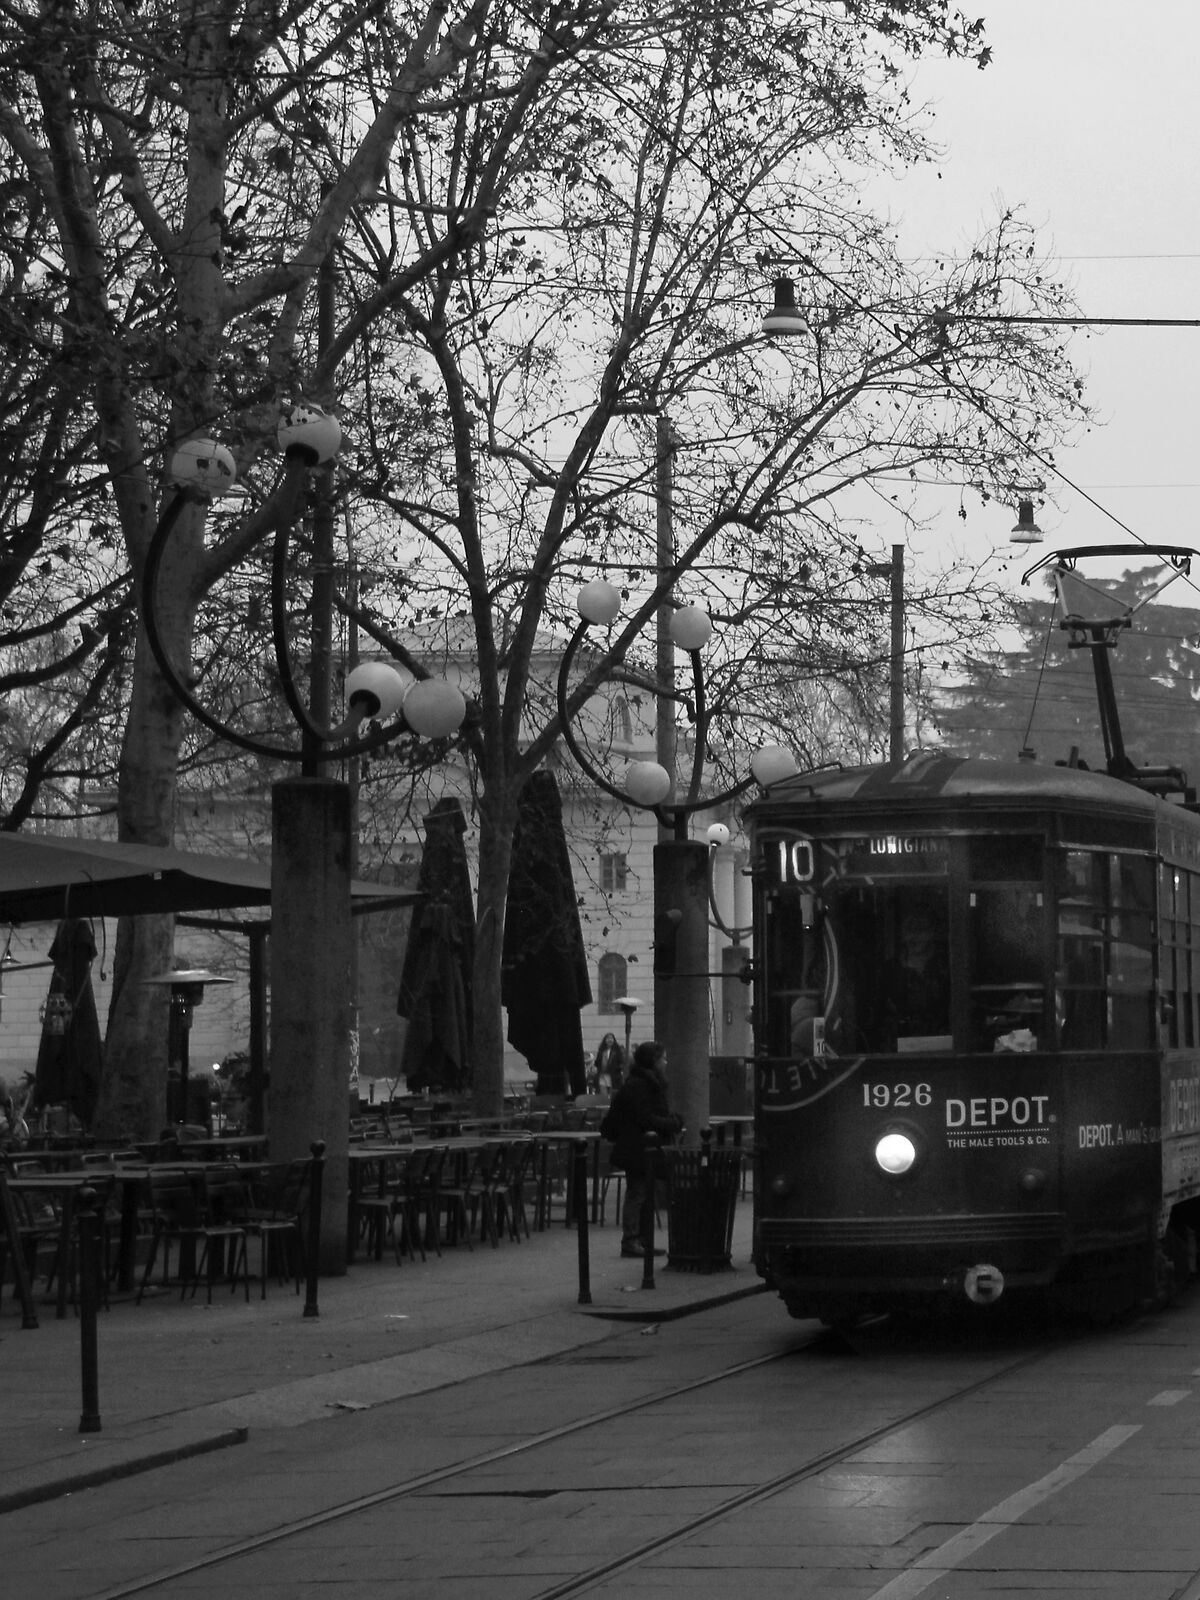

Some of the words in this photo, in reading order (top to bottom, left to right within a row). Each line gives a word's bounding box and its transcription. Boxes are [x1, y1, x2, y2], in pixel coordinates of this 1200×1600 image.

[870, 838, 944, 854] LUNIGIAN
[779, 840, 814, 883] 10
[863, 1083, 932, 1108] 1926
[947, 1138, 967, 1149] THE
[969, 1137, 994, 1148] MALE
[997, 1135, 1025, 1146] TOOLS
[1027, 1134, 1035, 1145] &
